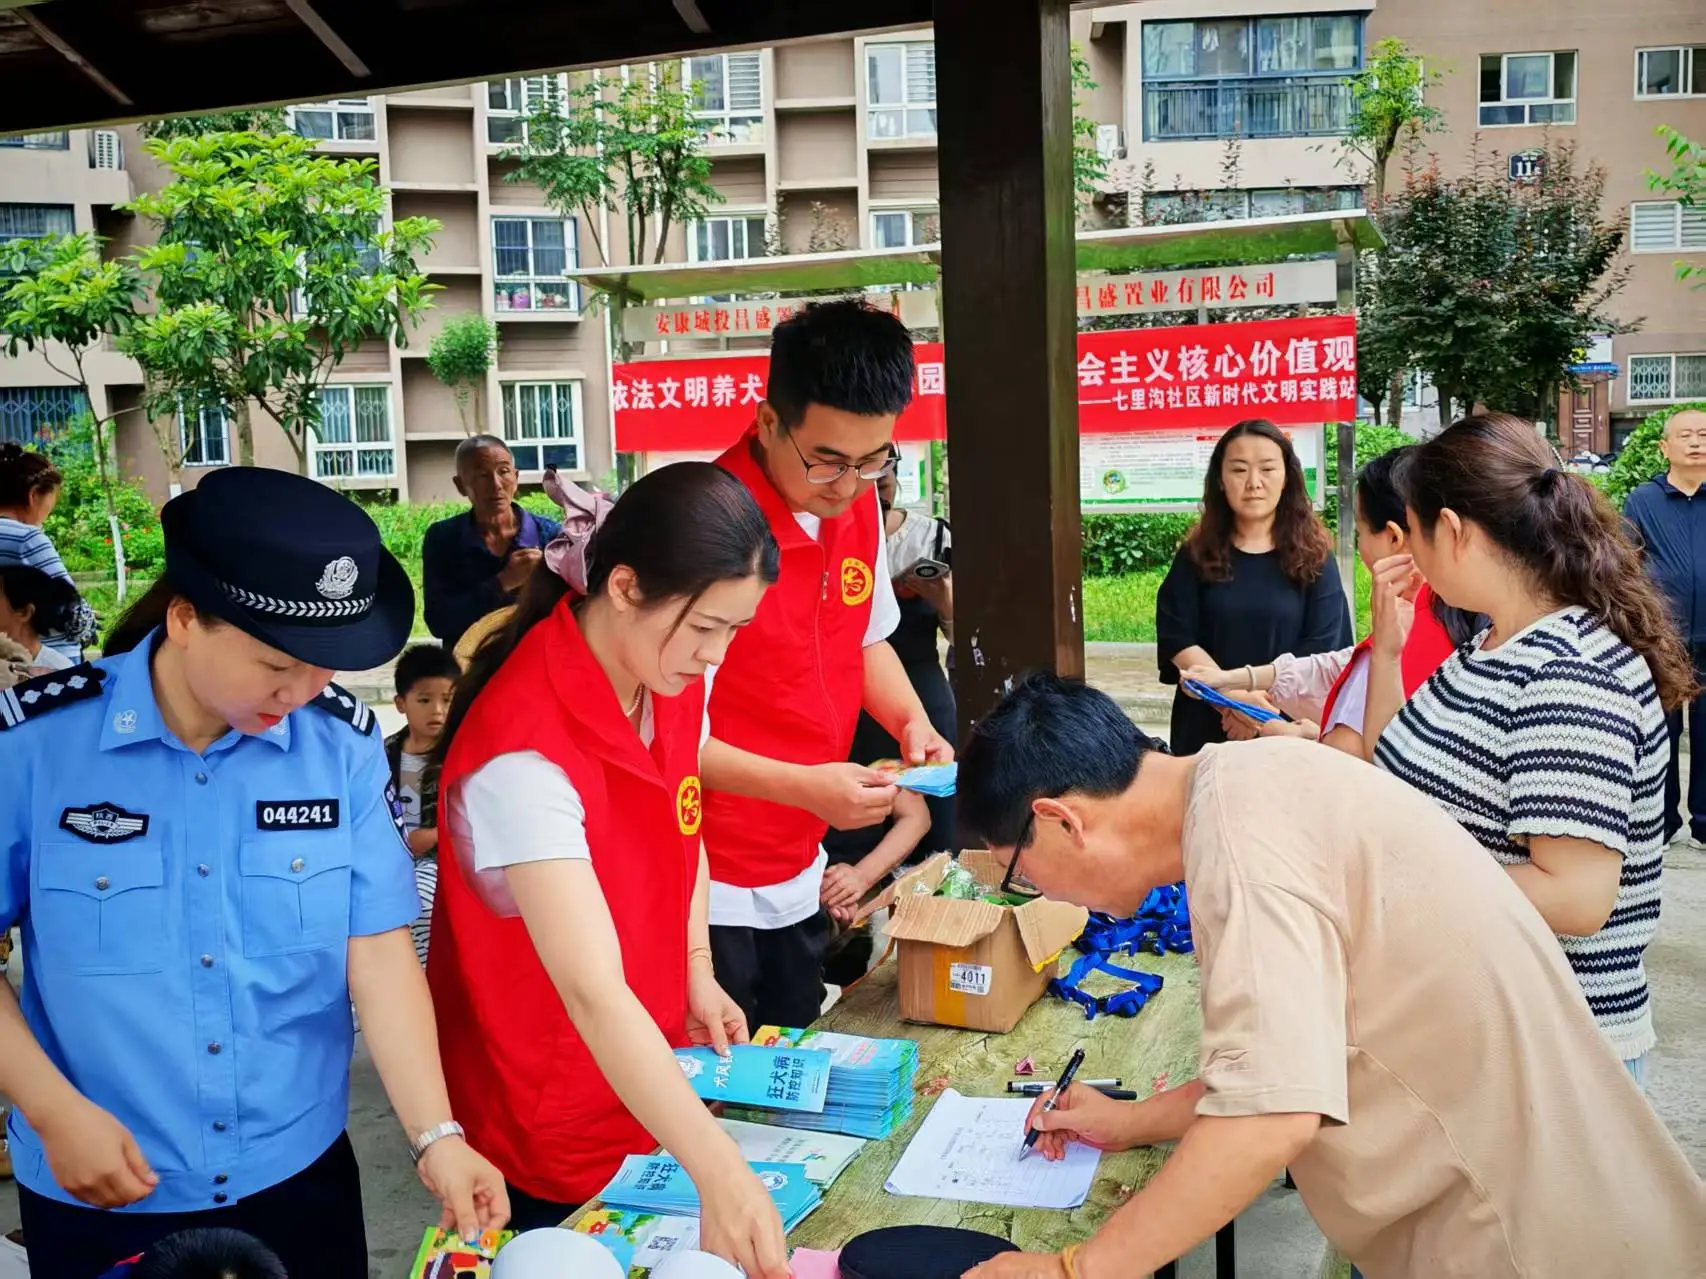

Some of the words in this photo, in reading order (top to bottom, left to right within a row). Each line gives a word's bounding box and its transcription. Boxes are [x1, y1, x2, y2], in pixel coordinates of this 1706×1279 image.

[1076, 272, 1275, 309] 昌盛置业有限公司
[1077, 335, 1356, 386] 会主义核心价值观
[918, 362, 945, 396] 园
[263, 805, 333, 825] 044241
[961, 970, 985, 985] 4011
[766, 1055, 791, 1100] 狂犬病
